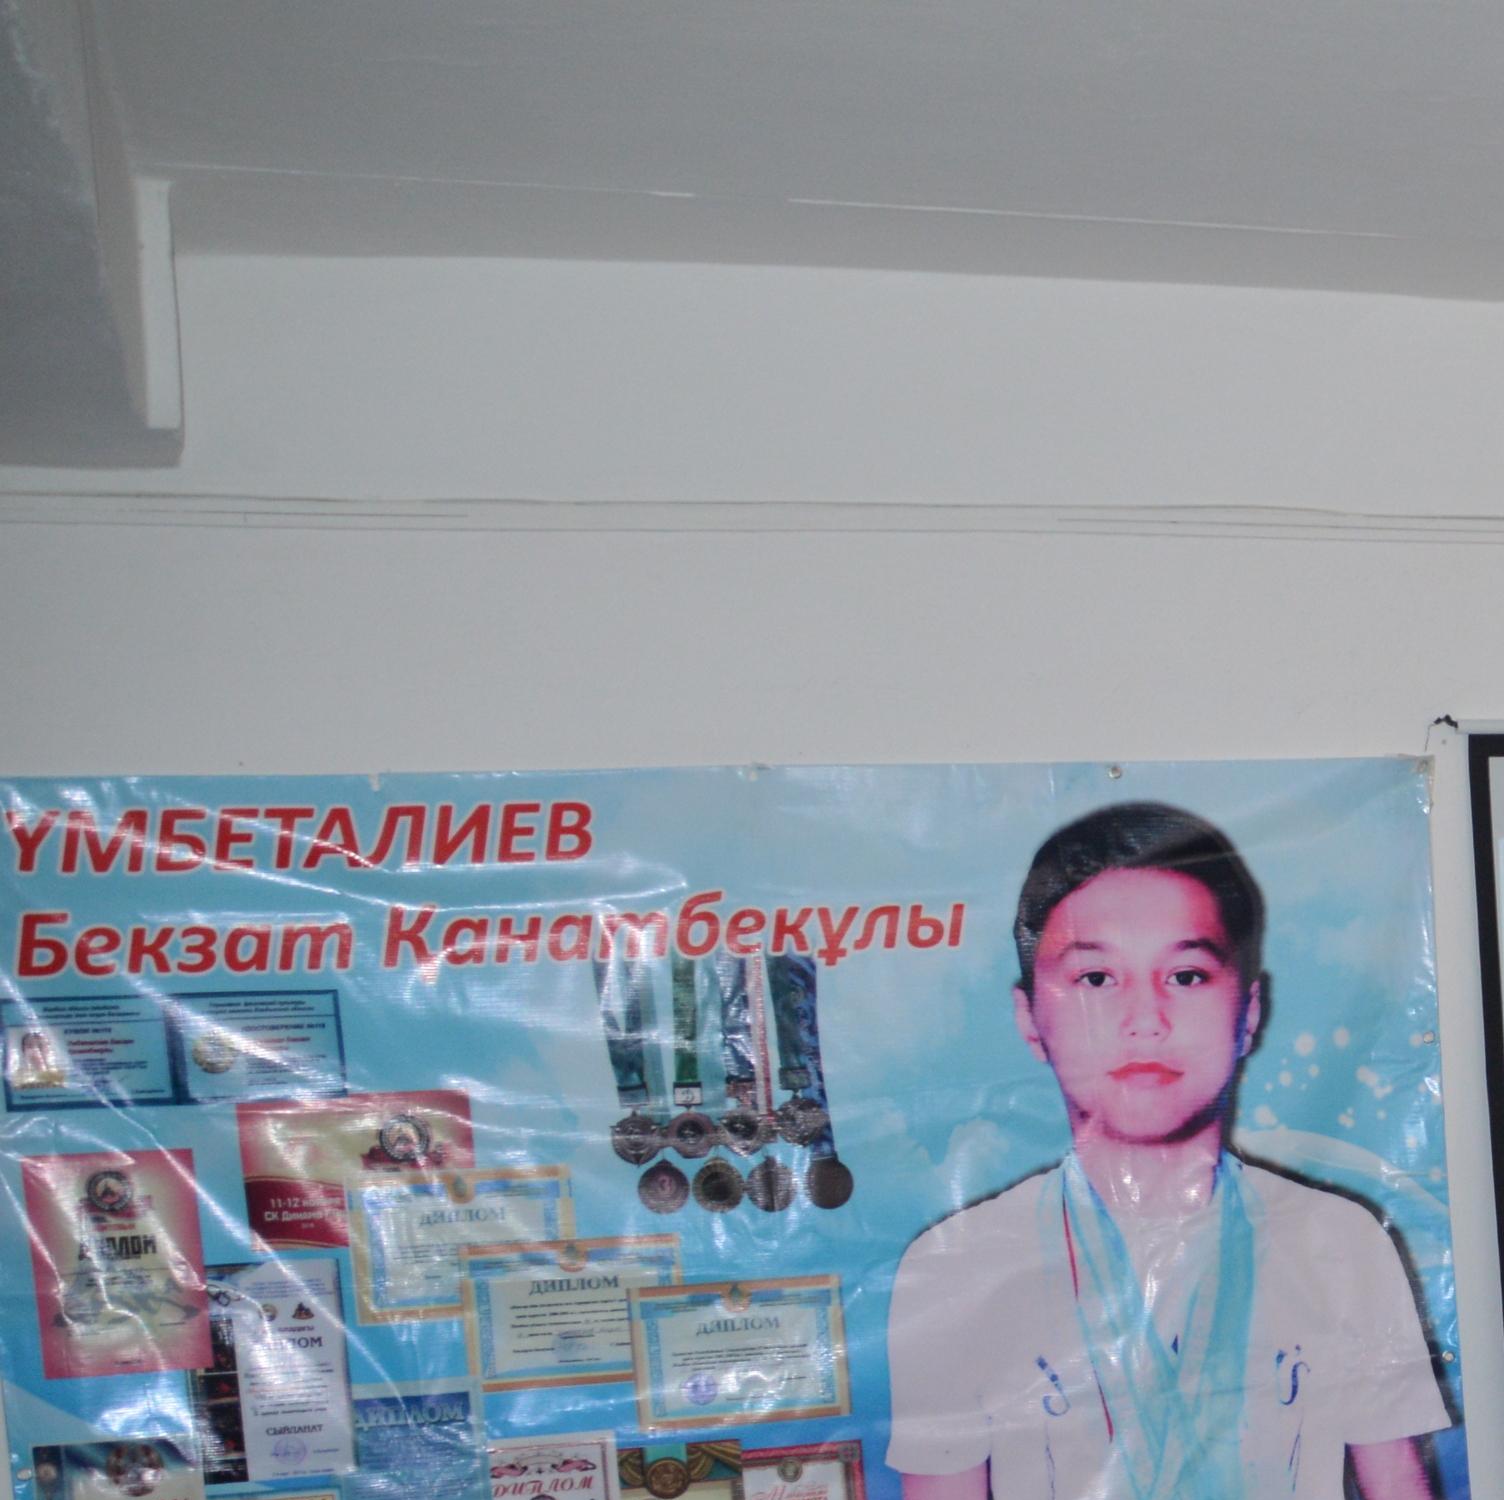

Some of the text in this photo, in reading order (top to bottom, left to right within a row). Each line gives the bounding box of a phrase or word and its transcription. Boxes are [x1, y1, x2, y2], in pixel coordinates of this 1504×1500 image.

[7, 801, 594, 874] ҮМБЕТАЛИЕВ
[17, 890, 967, 985] Бекзат Қанатбекұлы
[528, 1275, 620, 1296] ДИПЛОМ
[695, 1315, 781, 1336] ДИПЛОМ
[494, 1476, 594, 1498] ДИПЛОМ
